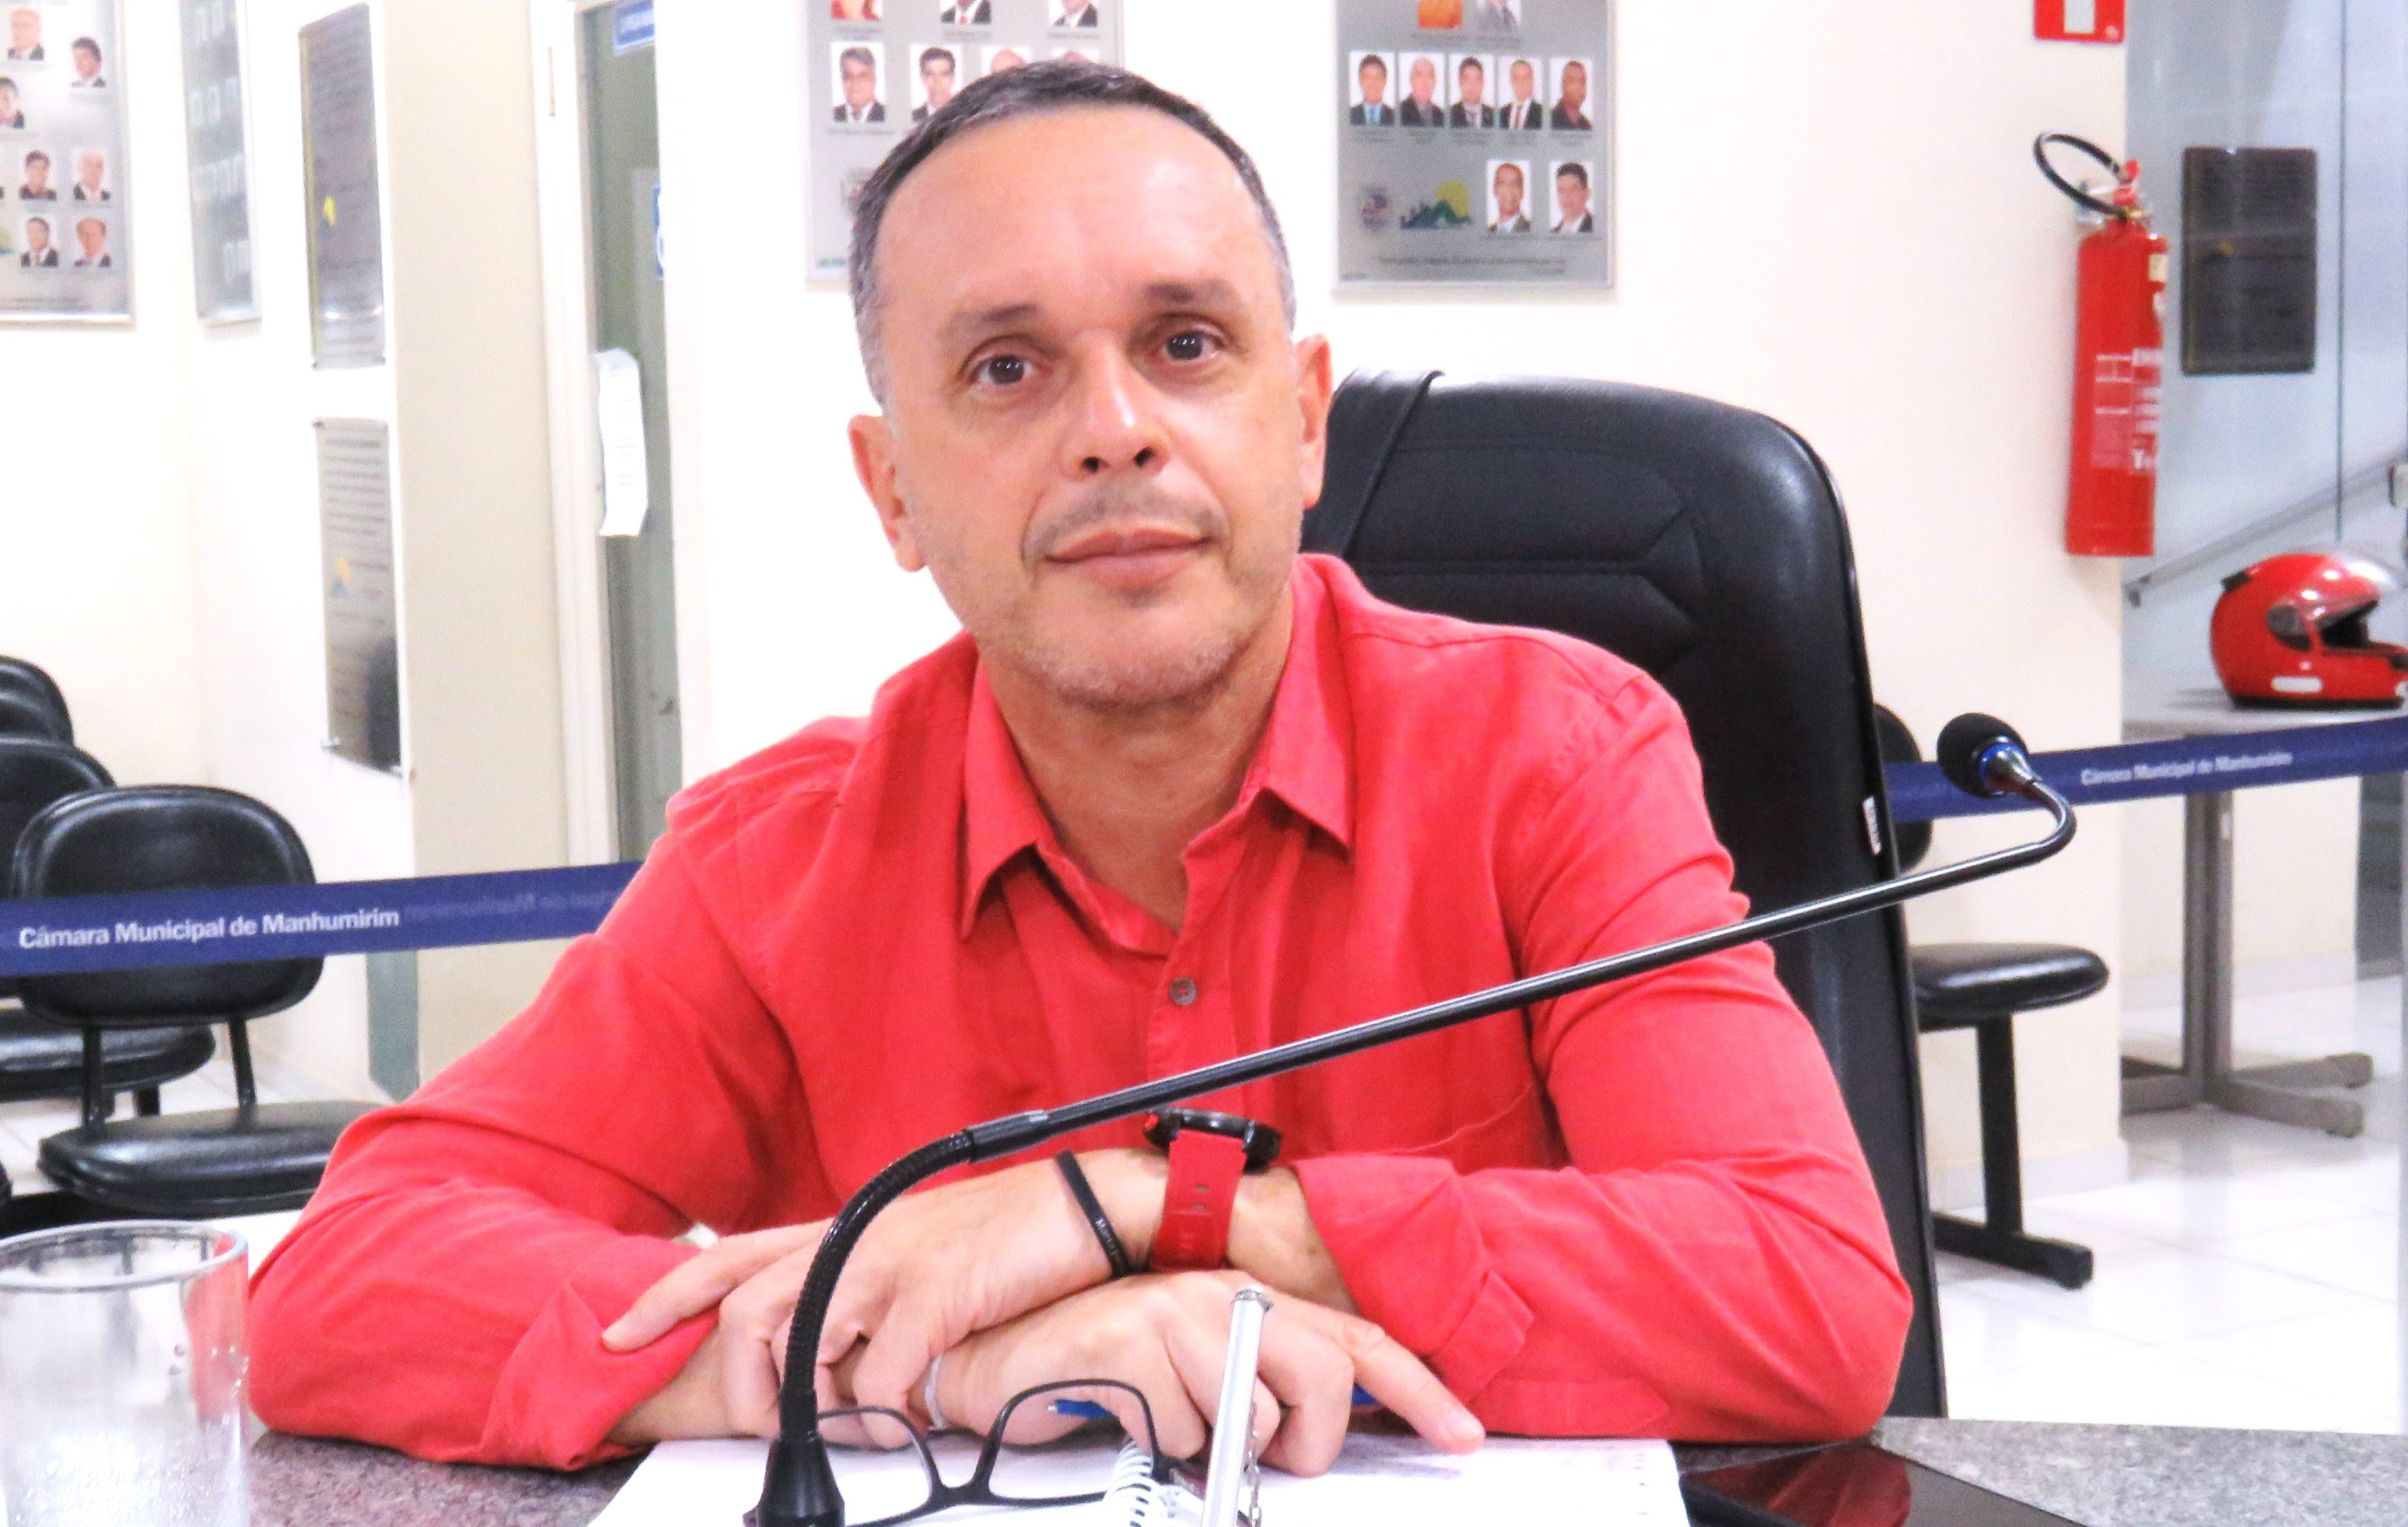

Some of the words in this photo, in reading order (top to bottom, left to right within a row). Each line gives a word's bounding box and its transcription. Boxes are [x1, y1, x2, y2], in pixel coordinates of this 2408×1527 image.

[19, 925, 109, 949] Câmara
[115, 917, 225, 944] Municipal
[230, 915, 257, 937] de
[262, 907, 399, 934] Manhumirim
